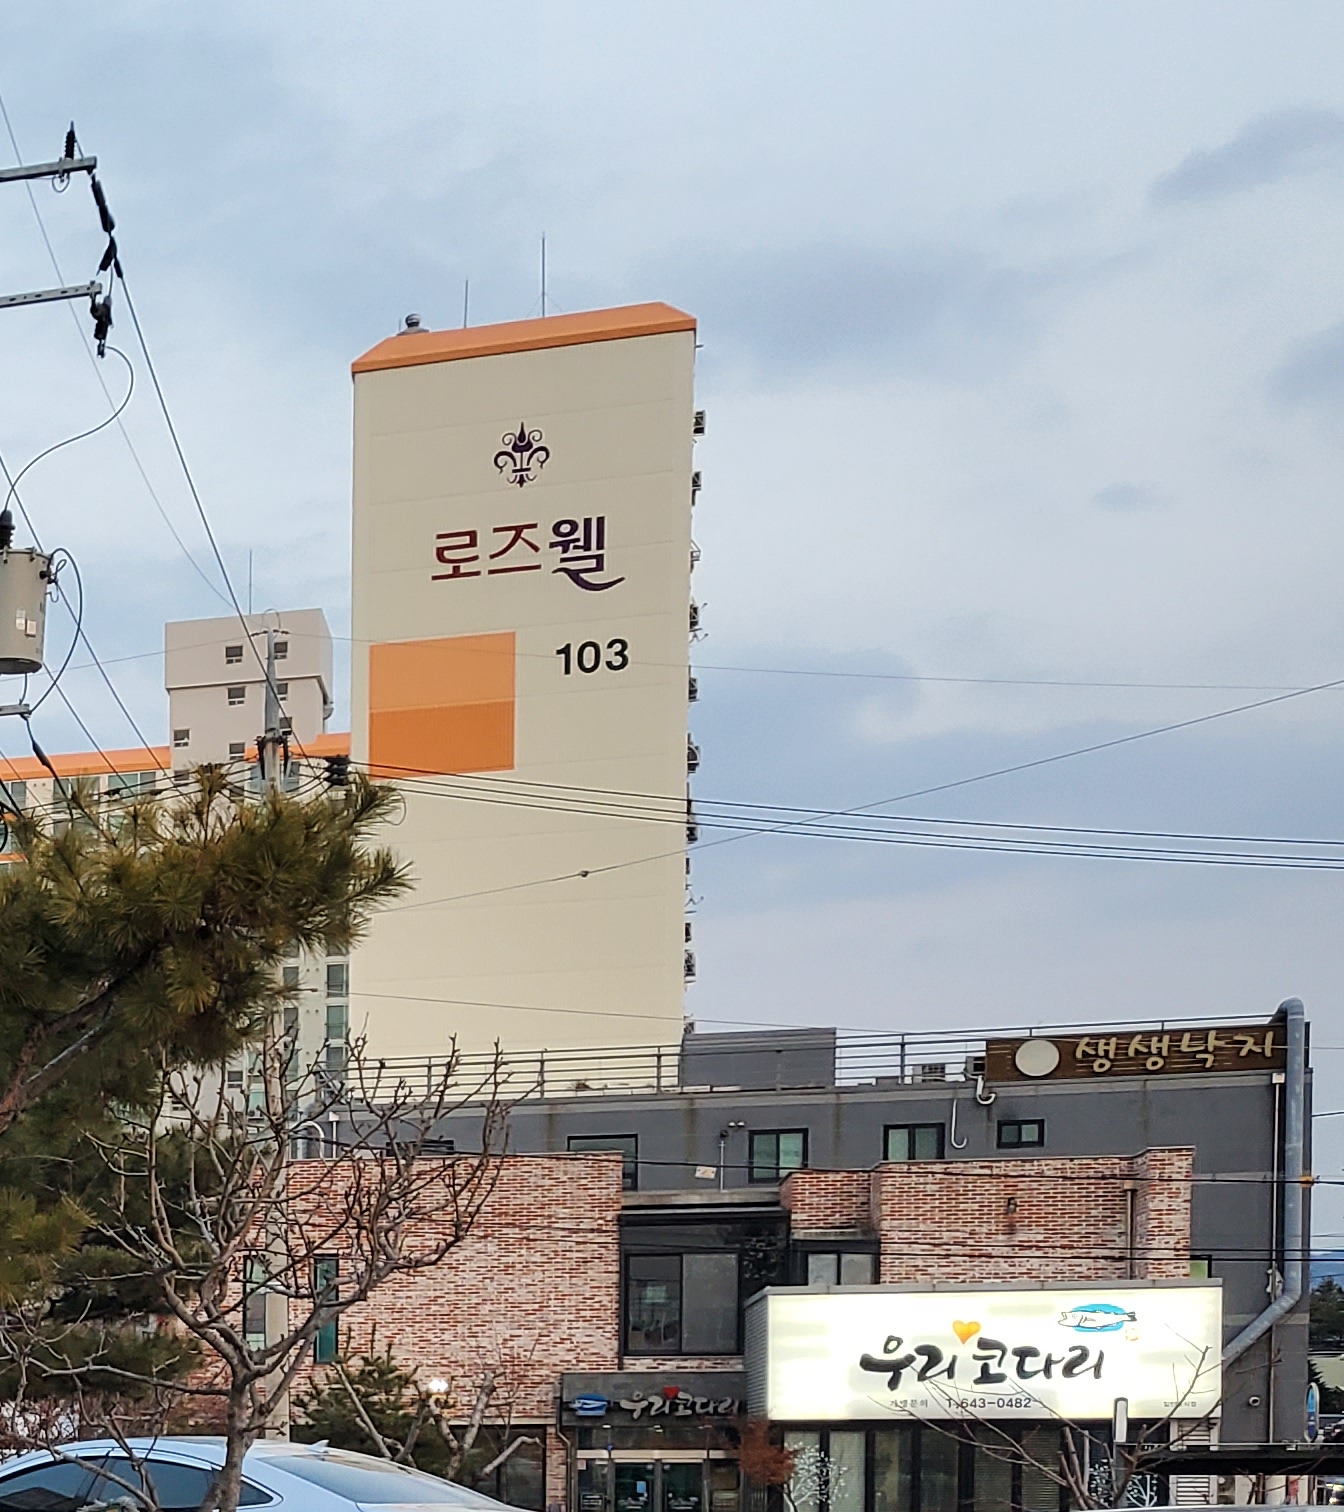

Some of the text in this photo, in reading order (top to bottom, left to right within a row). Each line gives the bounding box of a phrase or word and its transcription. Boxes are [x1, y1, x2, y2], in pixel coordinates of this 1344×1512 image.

[431, 516, 625, 592] 로즈웰
[556, 638, 629, 675] 103
[1075, 1030, 1274, 1073] 생생낙지
